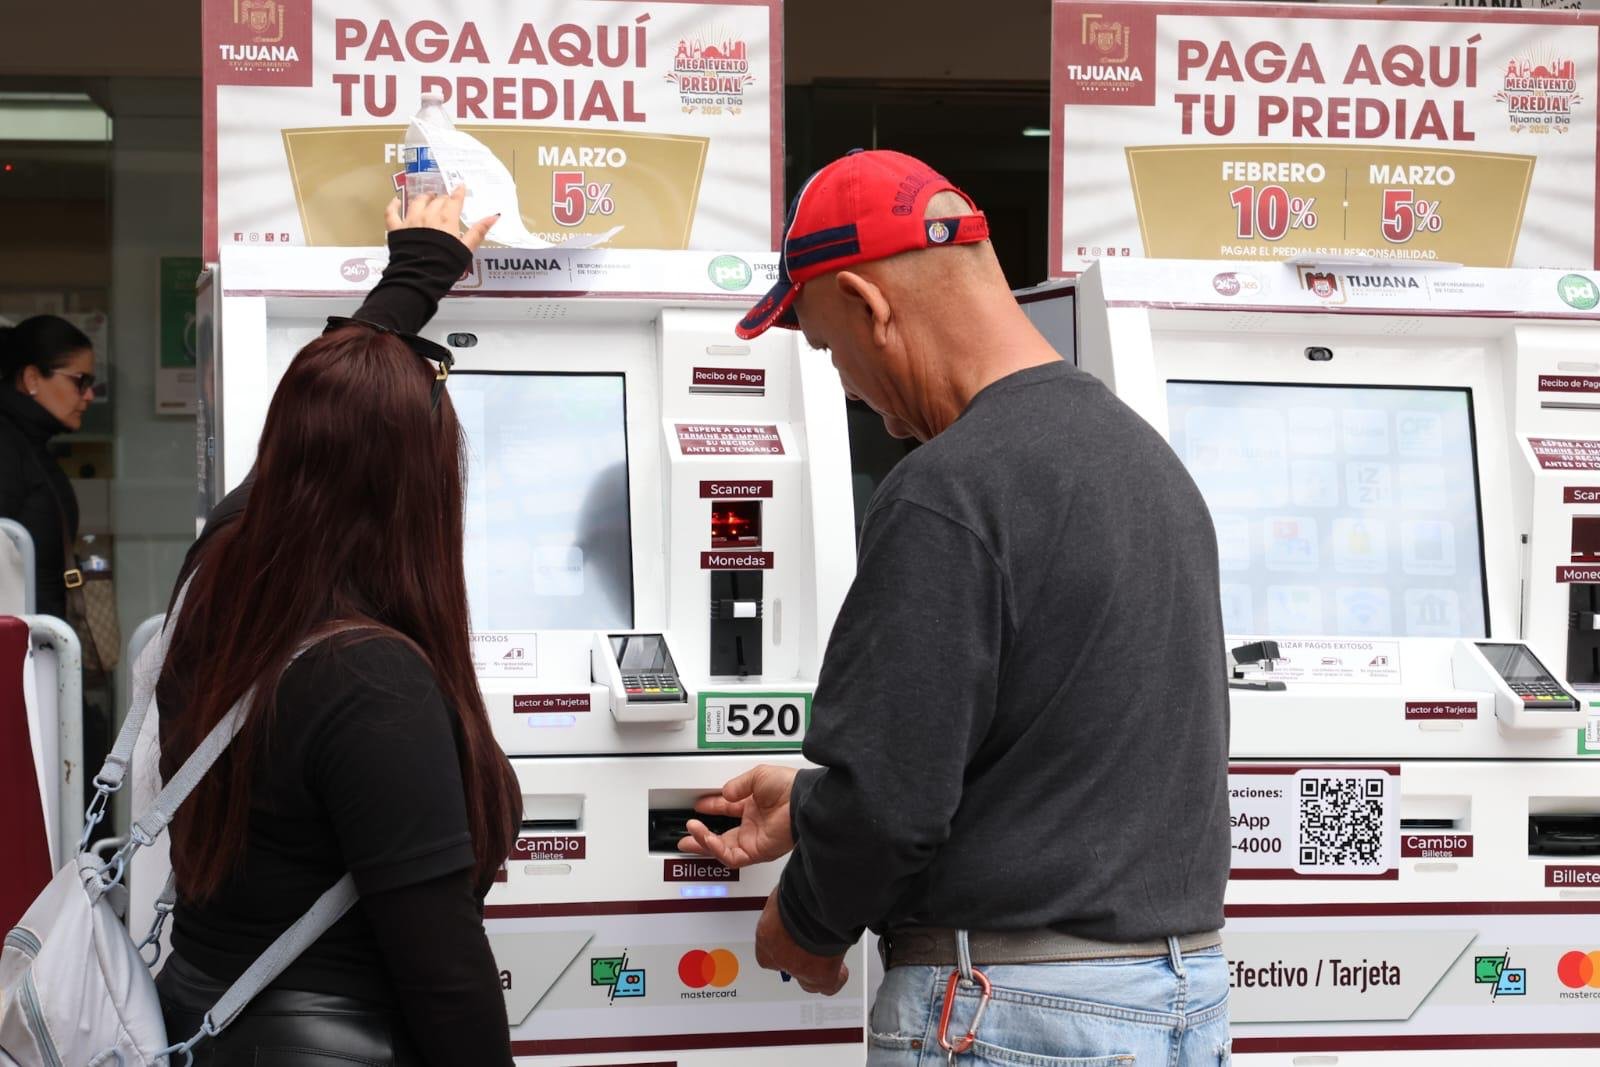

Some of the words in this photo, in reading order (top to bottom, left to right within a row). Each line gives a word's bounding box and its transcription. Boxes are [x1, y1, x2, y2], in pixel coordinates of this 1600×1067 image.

[335, 19, 490, 63] PAGA
[508, 12, 650, 67] AQUÍ
[219, 44, 299, 61] TIJUANA
[1178, 39, 1325, 83] PAGA
[1342, 33, 1482, 88] AQUÍ
[1067, 65, 1143, 81] TIJUANA
[681, 77, 741, 93] PREDIAL
[332, 73, 397, 118] TU
[421, 76, 646, 123] PREDIAL
[681, 96, 713, 105] Tijuana
[716, 97, 725, 105] al
[1511, 97, 1569, 111] PREDIAL
[1175, 94, 1235, 136] TU
[1259, 96, 1475, 142] PREDIAL
[1510, 115, 1541, 124] Tijuana
[1544, 116, 1553, 124] al
[538, 146, 627, 168] MARZO
[1222, 161, 1326, 183] FEBRERO
[1370, 165, 1456, 186] MARZO
[552, 171, 615, 227] 5%
[1230, 185, 1318, 241] 10%
[1381, 188, 1443, 243] 5%
[1221, 246, 1256, 256] PAGAR
[1259, 247, 1270, 256] EL
[484, 258, 562, 271] TIJUANA
[1346, 275, 1420, 288] TIJUANA
[695, 371, 725, 380] Recibo
[740, 373, 762, 383] Pago
[1541, 379, 1569, 388] Recibo
[1570, 379, 1581, 387] de
[710, 484, 762, 495] Scanner
[708, 555, 766, 566] Monedas
[1304, 642, 1332, 650] PAGOS
[514, 699, 541, 707] Lector
[543, 699, 554, 707] de
[556, 698, 590, 708] Tarjetas
[1406, 706, 1431, 714] Lector
[1433, 706, 1444, 714] de
[1446, 706, 1477, 716] Tarjetas
[727, 703, 800, 737] 520
[1230, 812, 1270, 831] sApp
[515, 837, 579, 851] Cambio
[1231, 837, 1282, 853] -4000
[1407, 835, 1468, 850] Cambio
[530, 852, 563, 861] Billetes
[1421, 850, 1453, 858] Billetes
[672, 864, 731, 878] Billetes
[1553, 869, 1600, 884] Billete
[1314, 959, 1323, 987] /
[1329, 958, 1401, 993] Tarjeta
[680, 988, 737, 1000] mastercard
